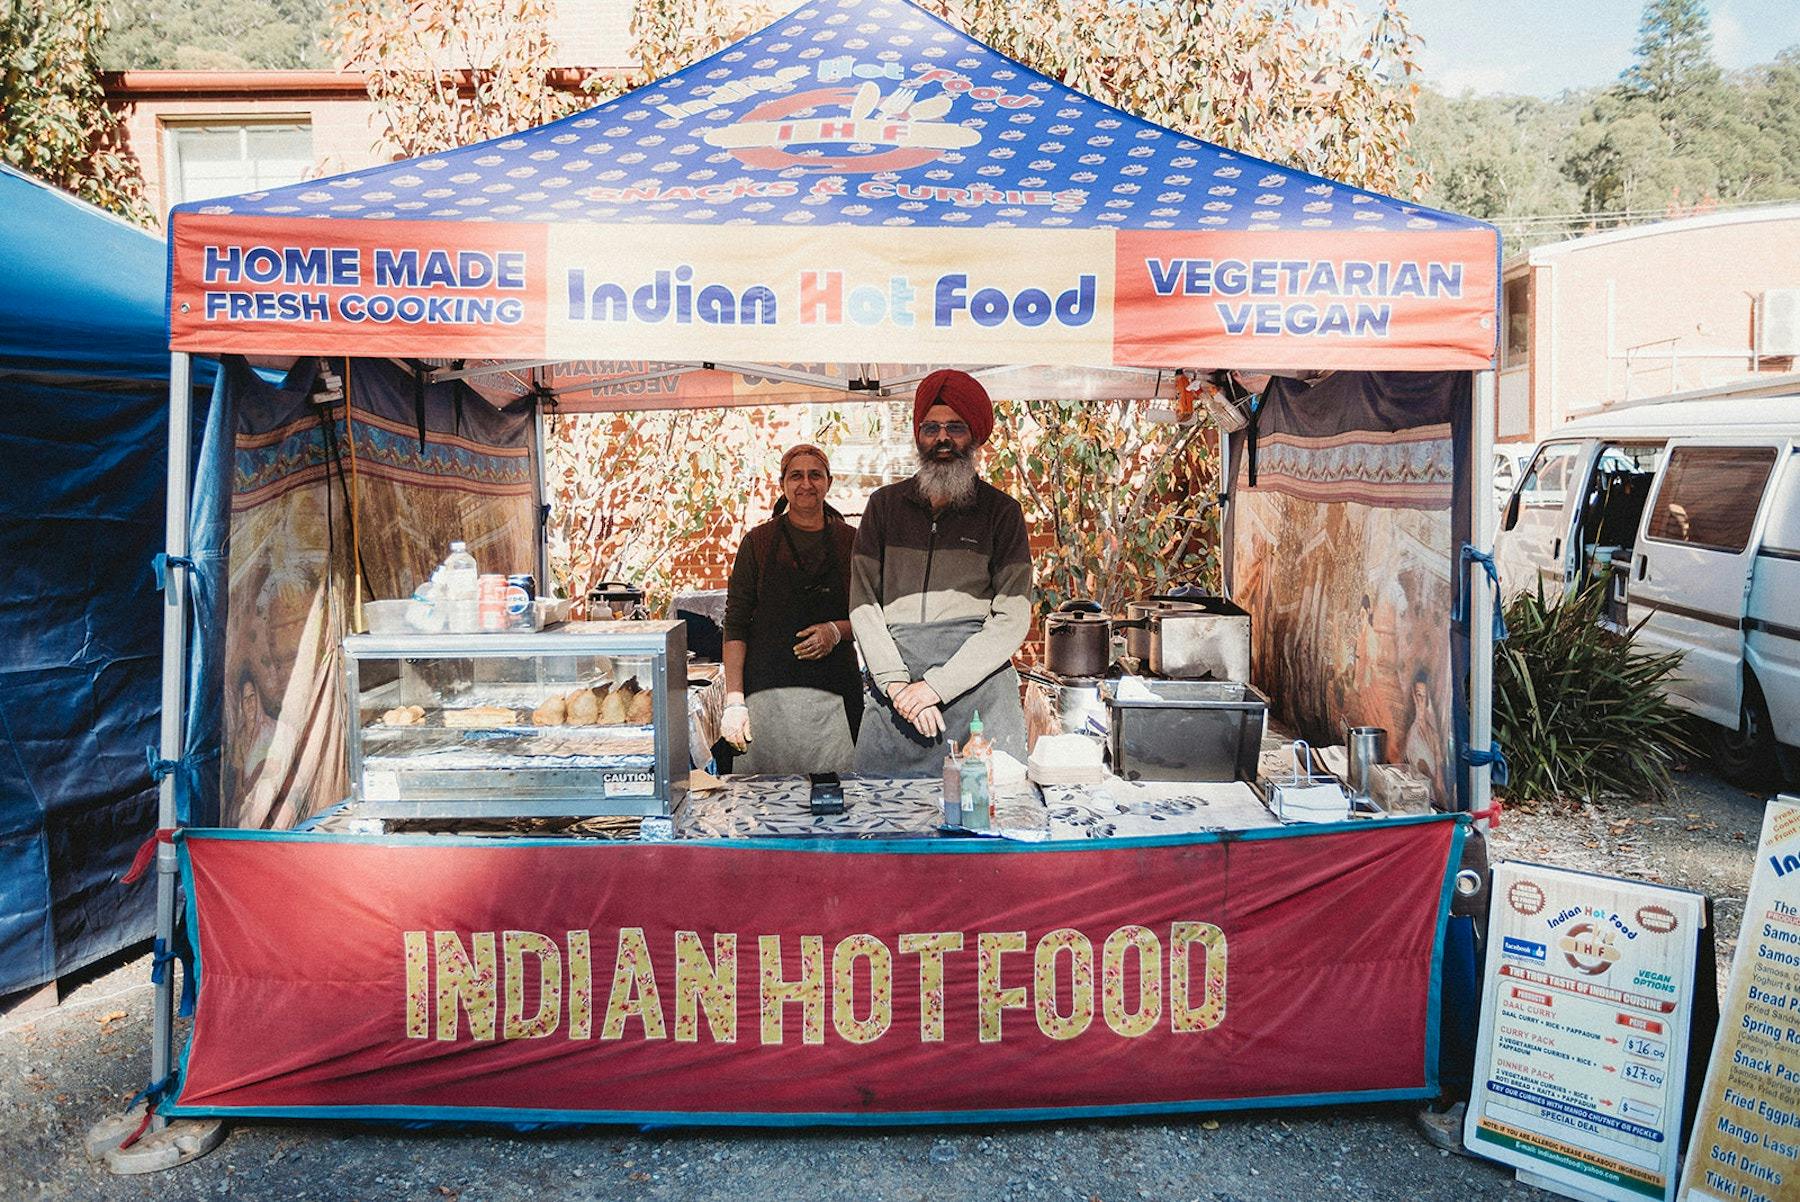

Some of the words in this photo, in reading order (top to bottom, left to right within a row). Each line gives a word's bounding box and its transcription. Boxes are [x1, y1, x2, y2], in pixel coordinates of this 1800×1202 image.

[817, 59, 905, 82] Hot
[587, 181, 799, 203] SNACKS
[814, 179, 847, 196] &
[859, 181, 1088, 207] CURRIES
[204, 246, 360, 287] HOME
[374, 249, 526, 290] MADE
[1145, 258, 1464, 299] VEGETARIAN
[205, 292, 331, 322] FRESH
[340, 294, 524, 325] COOKING
[567, 265, 778, 326] Indian
[800, 271, 917, 327] Hot
[934, 274, 1099, 328] Food
[1216, 302, 1392, 338] VEGAN
[603, 772, 655, 782] CAUTION
[1774, 900, 1797, 916] The
[1547, 906, 1581, 929] Indian
[1585, 906, 1606, 919] Hot
[1609, 914, 1638, 940] Food
[404, 927, 737, 1044] INDIAN
[758, 932, 963, 1045] HOT
[977, 921, 1228, 1043] FOOD
[1633, 977, 1676, 993] OPTIONS
[1638, 969, 1671, 982] VEGAN
[1503, 1000, 1524, 1011] DAAL
[1527, 1006, 1557, 1018] CURRY
[1622, 992, 1662, 1012] CUISINE
[1748, 985, 1786, 1008] Bread
[1500, 1026, 1528, 1039] CURRY
[1531, 1033, 1556, 1046] PACK
[1502, 1010, 1517, 1018] DAAL
[1519, 1014, 1539, 1023] CURRY
[1545, 1021, 1559, 1030] RICE
[1566, 1027, 1600, 1040] PAPPADUM
[1742, 1014, 1782, 1041] Spring
[1499, 1043, 1531, 1055] PAPPADUM
[1504, 1037, 1542, 1052] VEGETARIAN
[1543, 1047, 1570, 1060] CURRIES
[1577, 1056, 1591, 1066] RICE
[1734, 1049, 1773, 1074] Snack
[1497, 1058, 1528, 1073] DINNER
[1531, 1067, 1555, 1080] PACK
[1501, 1069, 1539, 1085] VEGETARIAN
[1540, 1080, 1567, 1093] CURRIES
[1573, 1090, 1588, 1100] RICE
[1511, 1078, 1531, 1090] BREAD
[1537, 1086, 1555, 1097] RAITA
[1562, 1094, 1597, 1109] PAPPADUM
[1492, 1084, 1503, 1094] TRY
[1505, 1087, 1517, 1097] OUR
[1519, 1091, 1546, 1105] CURRIES
[1546, 1099, 1563, 1111] WITH
[1563, 1104, 1587, 1117] MANGO
[1588, 1113, 1619, 1127] CHUTNEY
[1621, 1123, 1631, 1131] OR
[1632, 1127, 1658, 1140] PICKLE
[1724, 1088, 1756, 1111] Fried
[1540, 1108, 1575, 1126] SPECIAL
[1577, 1120, 1599, 1133] DEAL
[1717, 1117, 1759, 1144] Mango
[1762, 1134, 1799, 1160] Lassi
[1506, 1127, 1518, 1137] YOU
[1519, 1132, 1530, 1141] ARE
[1531, 1136, 1559, 1150] ALLERGIC
[1560, 1145, 1581, 1158] PLEASE
[1595, 1157, 1617, 1169] ABOUT
[1618, 1163, 1660, 1183] INGREDIENTS
[1711, 1145, 1737, 1167] Soft
[1740, 1156, 1782, 1185] Drinks
[1706, 1171, 1736, 1196] Tikki
